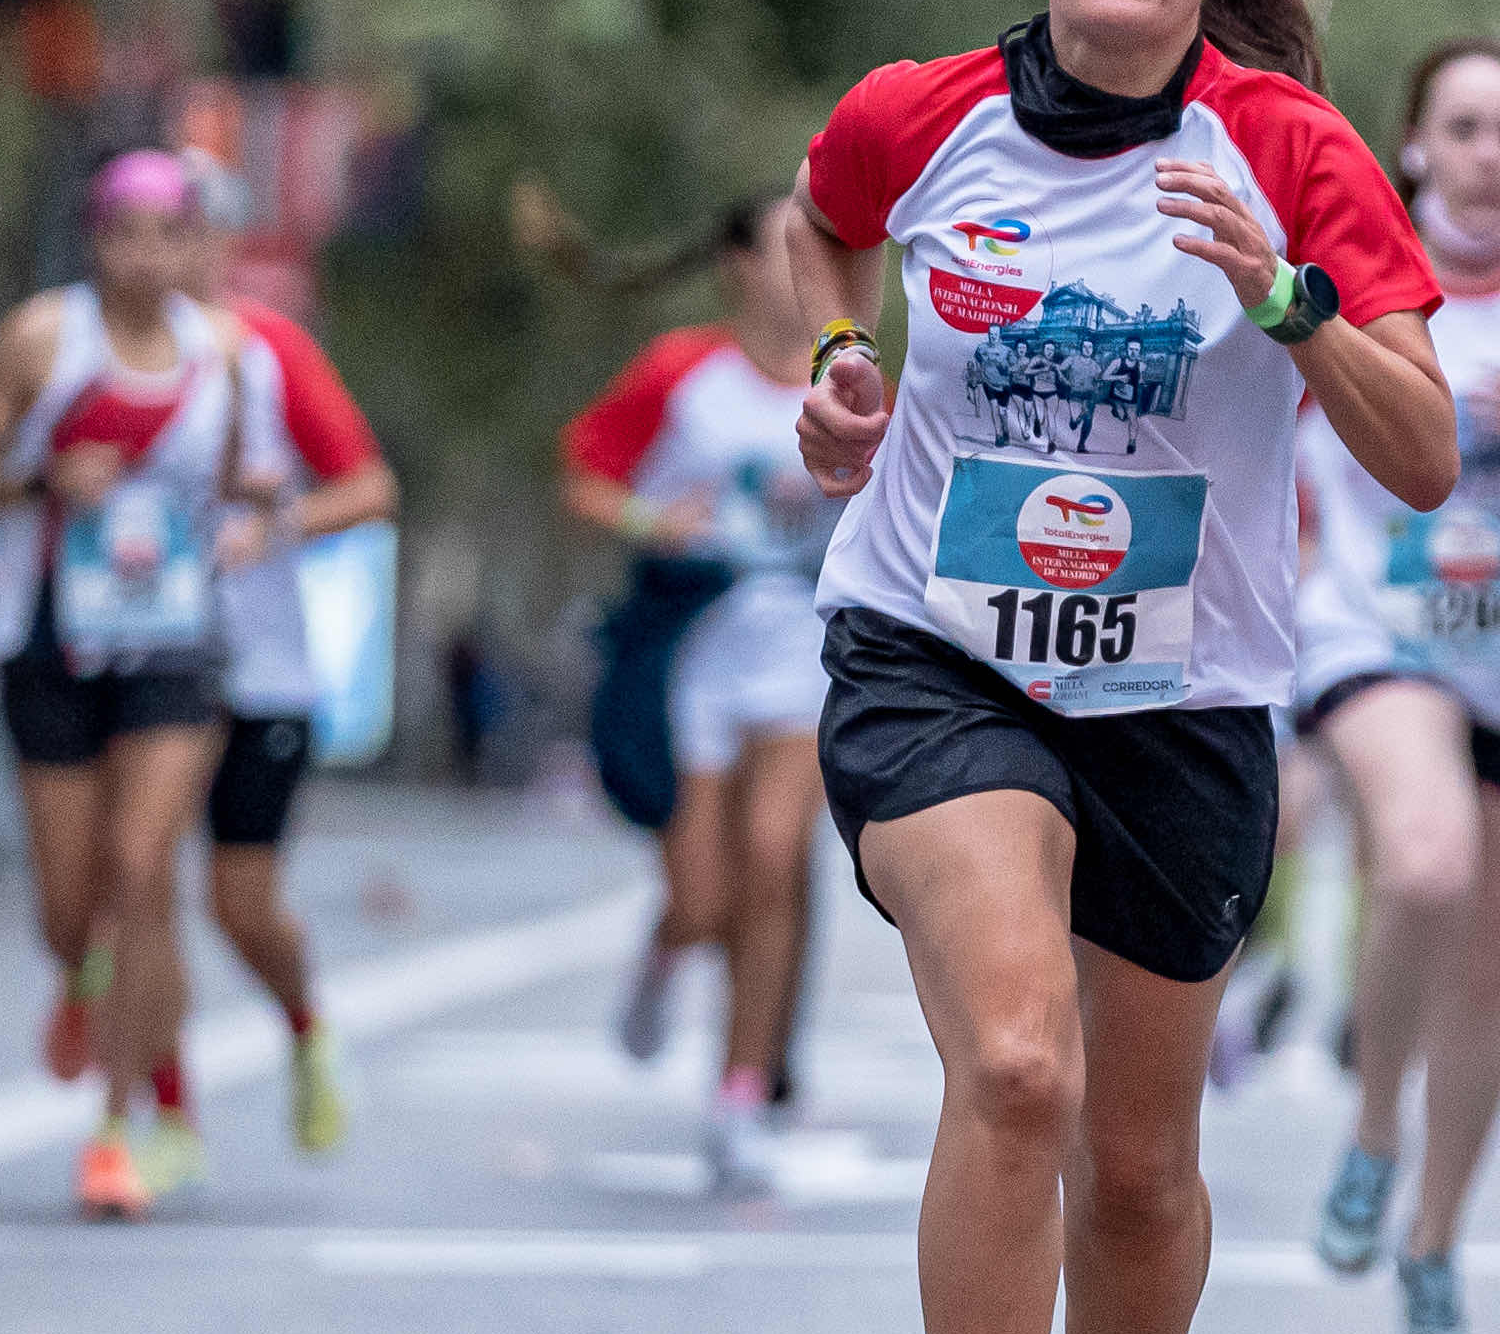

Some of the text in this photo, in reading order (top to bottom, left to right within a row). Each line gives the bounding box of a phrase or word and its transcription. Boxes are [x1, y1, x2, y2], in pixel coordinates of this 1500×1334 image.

[1043, 526, 1111, 543] TotalEnergies
[1058, 548, 1090, 561] MILLA
[1032, 555, 1112, 573] INTERNACIONAL
[1043, 567, 1101, 581] DE MADRID
[987, 587, 1138, 667] 1165
